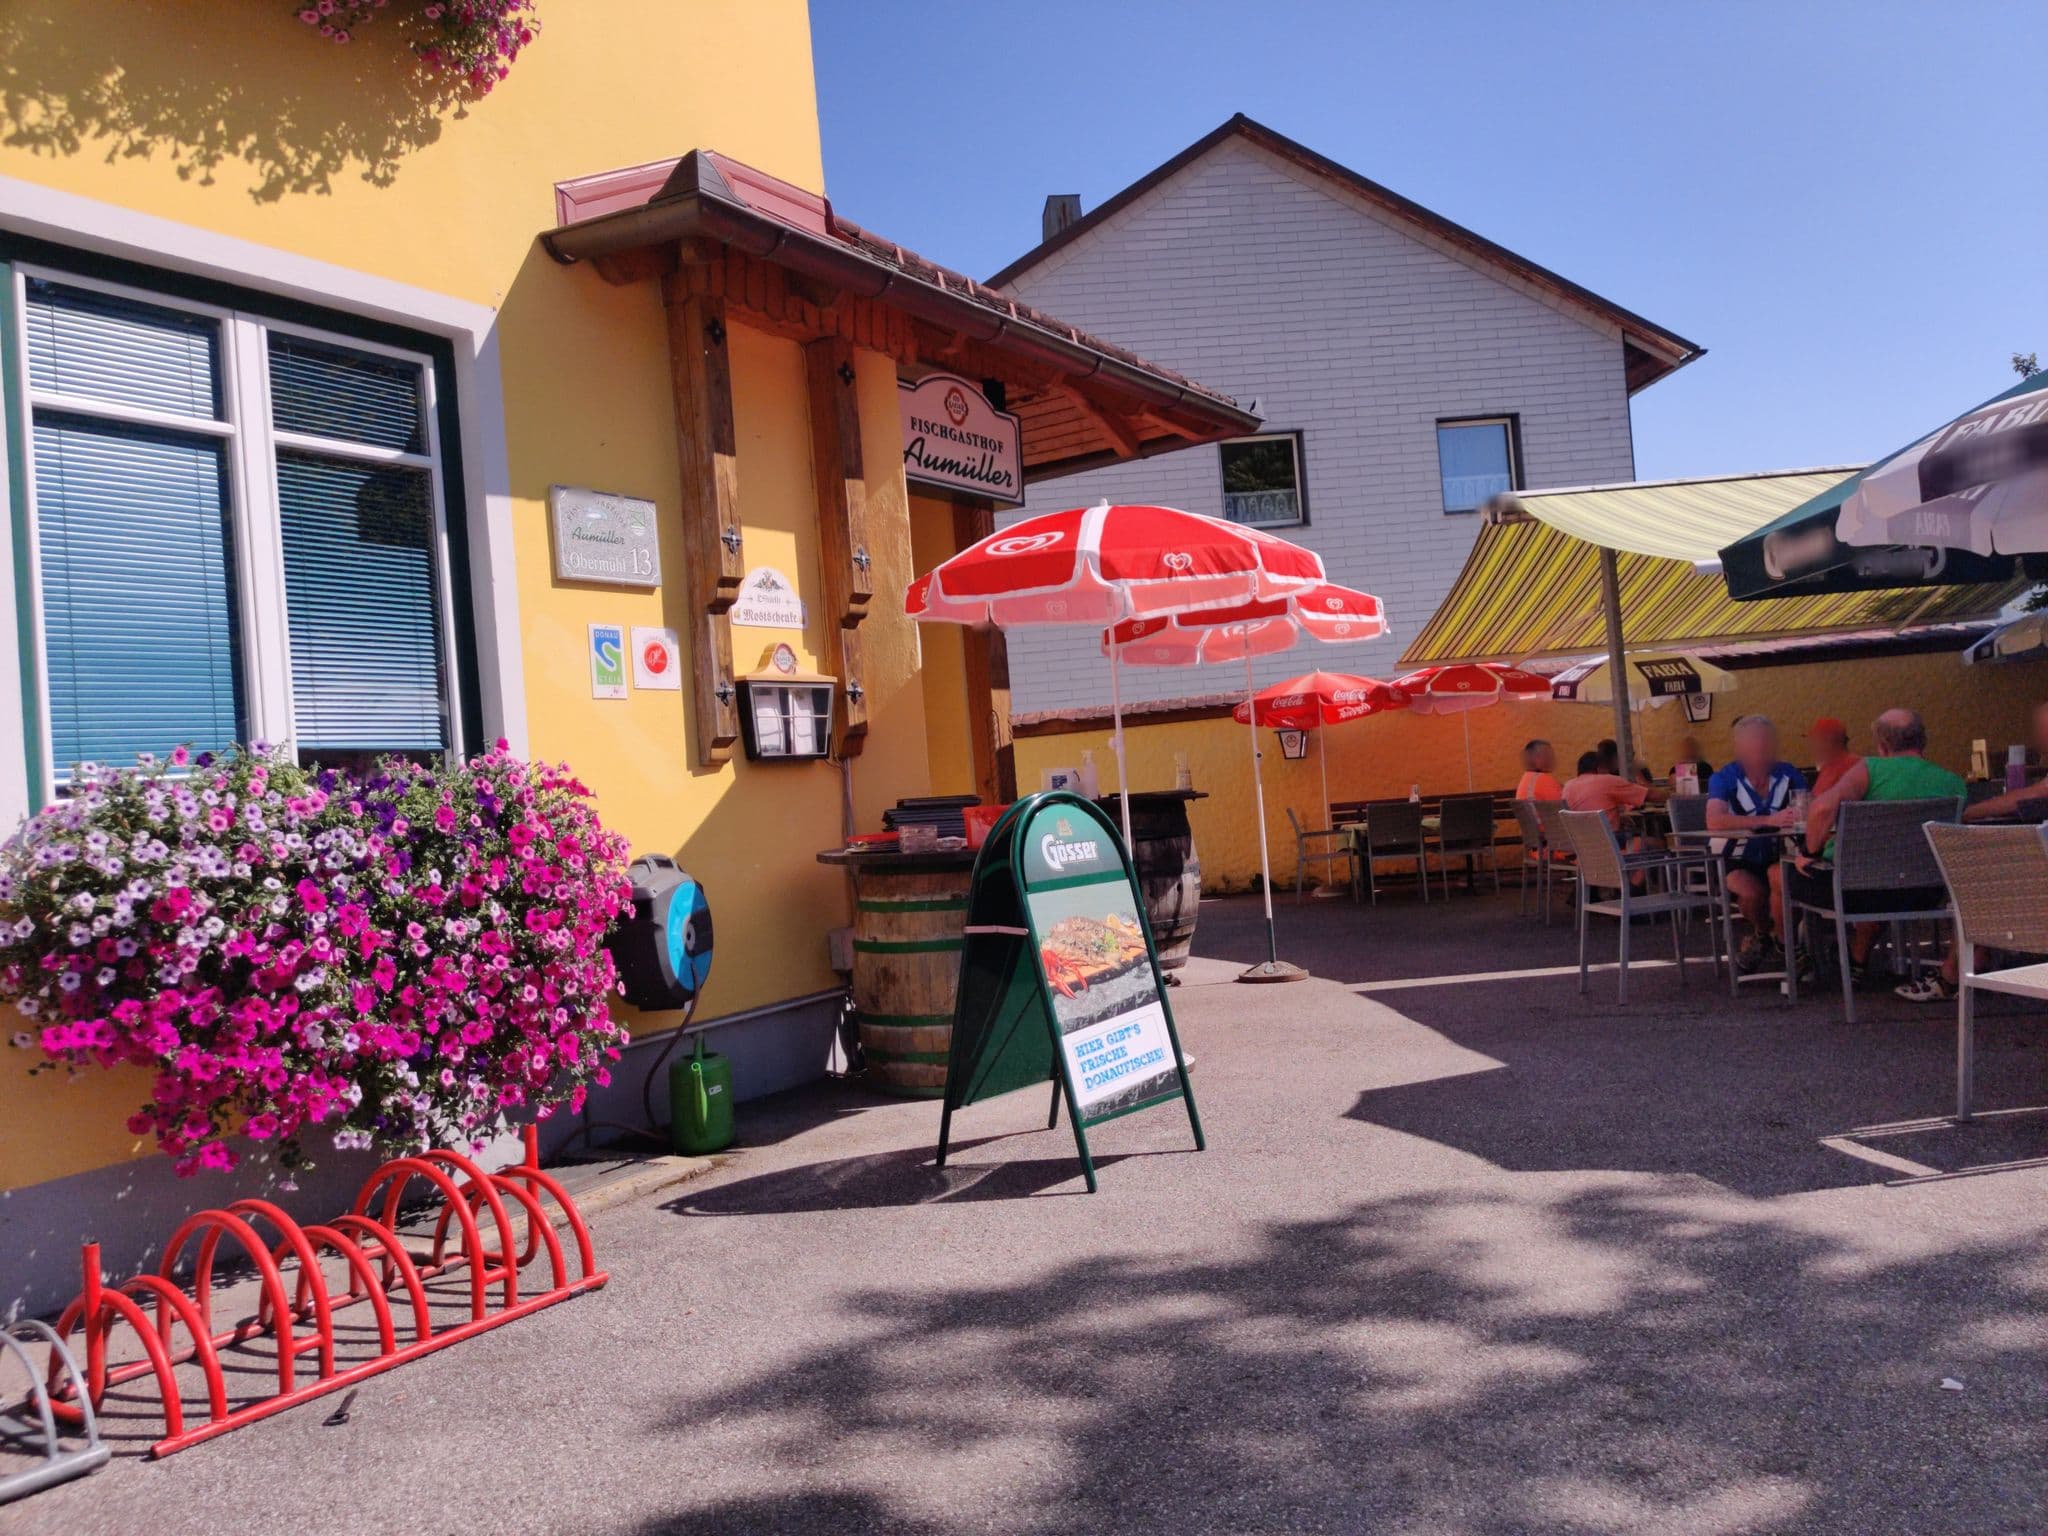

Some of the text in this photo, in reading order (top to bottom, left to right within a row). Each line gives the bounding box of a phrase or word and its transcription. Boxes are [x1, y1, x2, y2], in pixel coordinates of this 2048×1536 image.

[910, 415, 1004, 454] FISCHGASTHOF
[903, 436, 1013, 488] Aumüller
[571, 526, 625, 545] Aumüller
[630, 545, 653, 576] 13
[595, 630, 619, 640] DONAU
[1641, 661, 1696, 678] FABIA
[1041, 833, 1098, 872] Gösser
[1075, 1023, 1142, 1058] HIER GIBT'S
[1080, 1046, 1129, 1074] FRISCHE
[1084, 1047, 1166, 1090] DONAUFISCHE!
